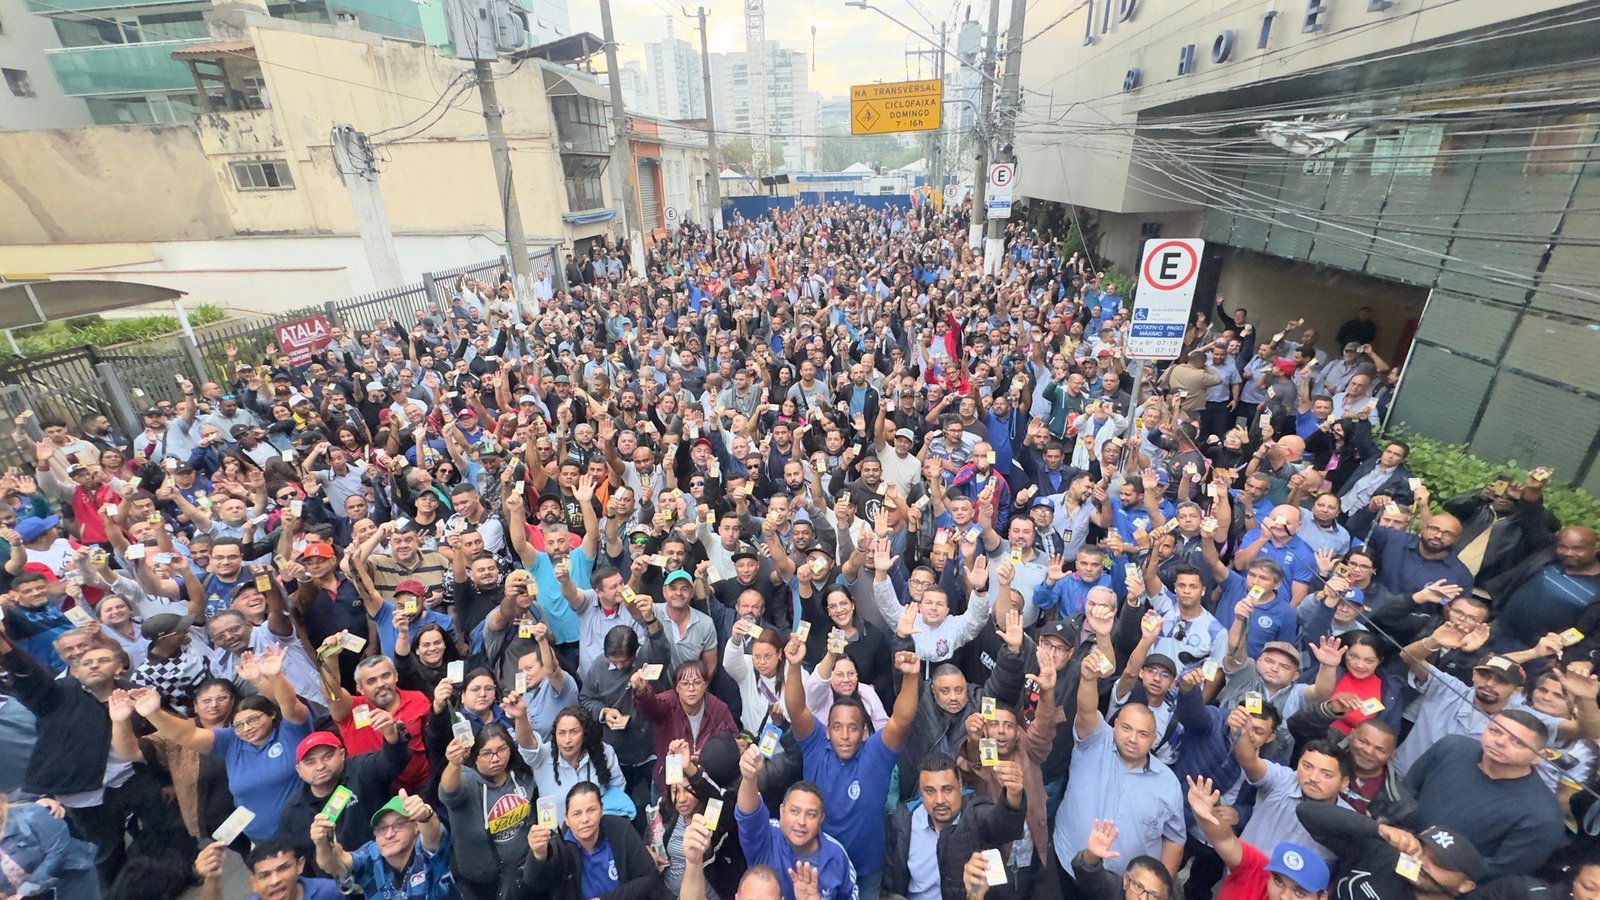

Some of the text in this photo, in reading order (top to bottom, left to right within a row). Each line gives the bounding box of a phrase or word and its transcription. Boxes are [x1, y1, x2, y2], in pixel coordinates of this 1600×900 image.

[855, 84, 937, 97] NA TRANSVERSAL
[885, 98, 936, 109] CICLOFAIXA
[890, 109, 930, 119] DOMINGO
[895, 120, 901, 128] 7
[909, 119, 924, 127] 16h
[997, 170, 1006, 182] E
[1159, 252, 1182, 279] E
[281, 320, 325, 344] ATALA
